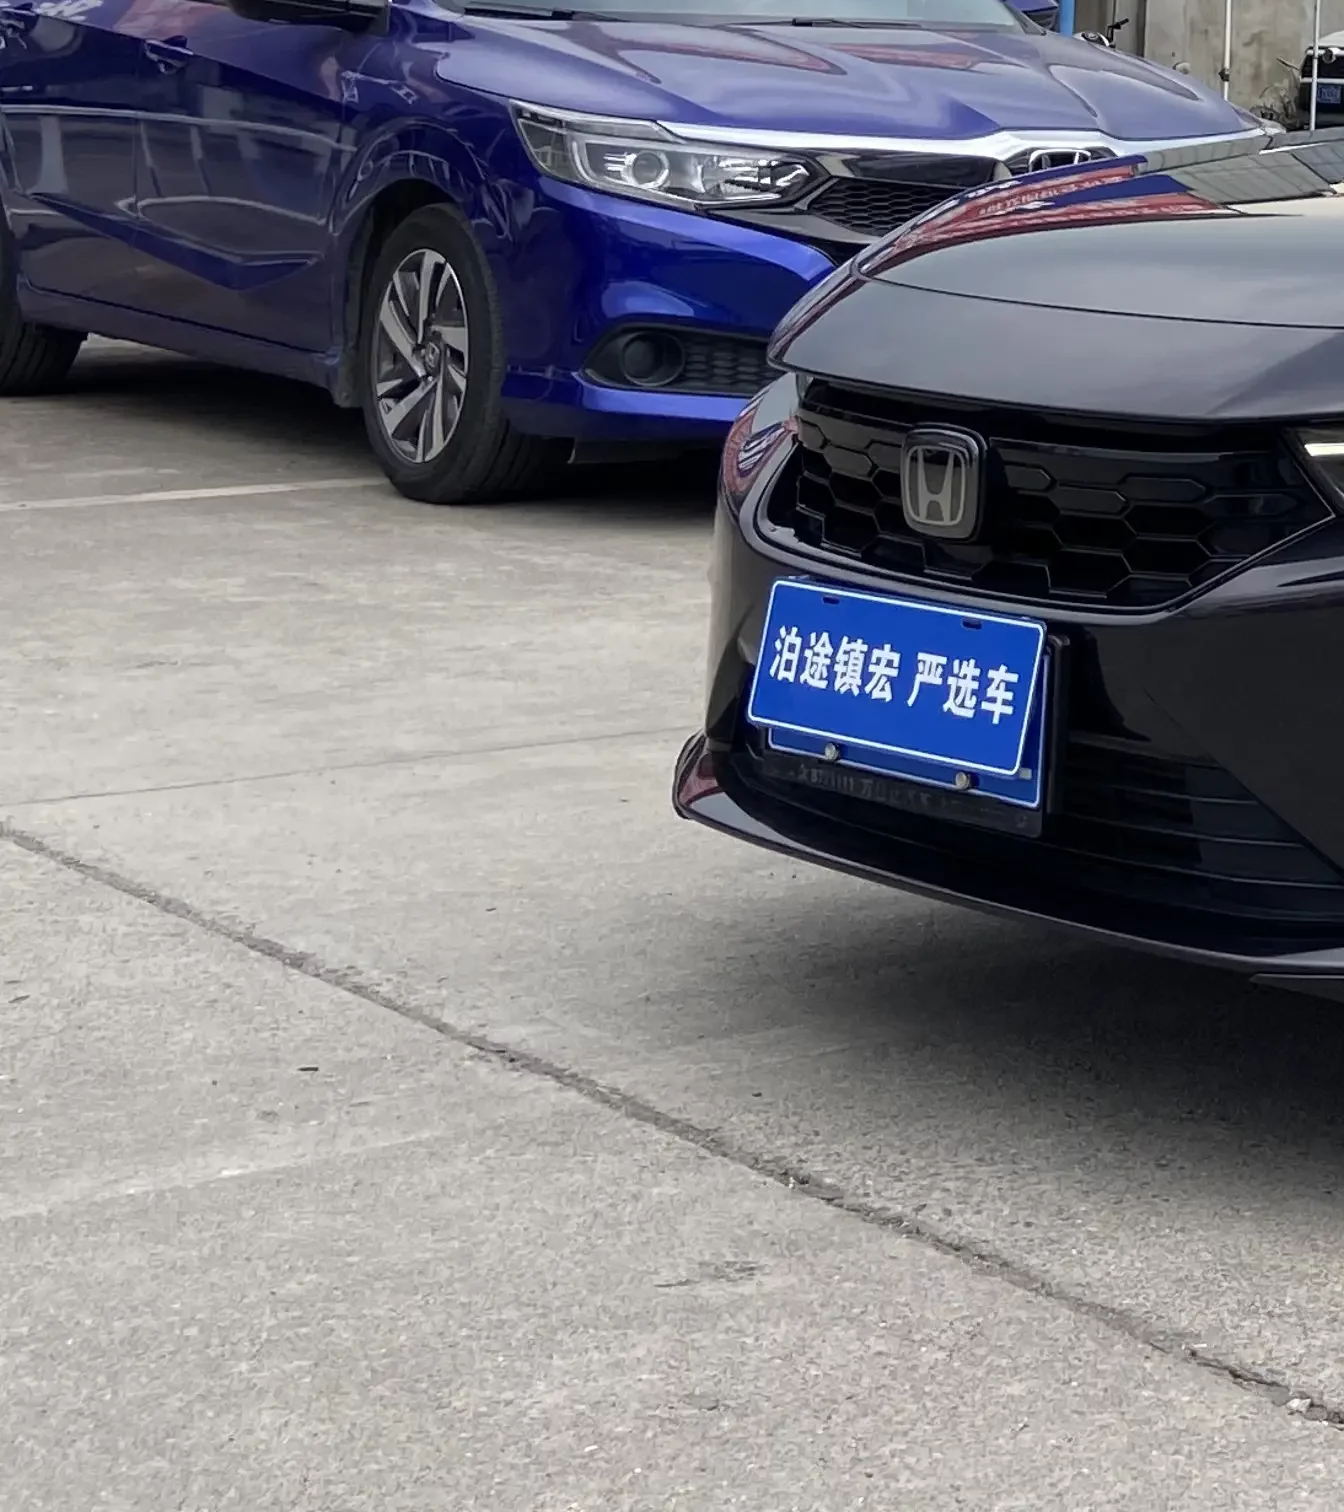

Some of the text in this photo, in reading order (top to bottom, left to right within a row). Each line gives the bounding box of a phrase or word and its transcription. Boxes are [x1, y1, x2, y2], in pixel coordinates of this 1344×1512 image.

[769, 626, 1020, 724] 泊途镇宏 严选车
